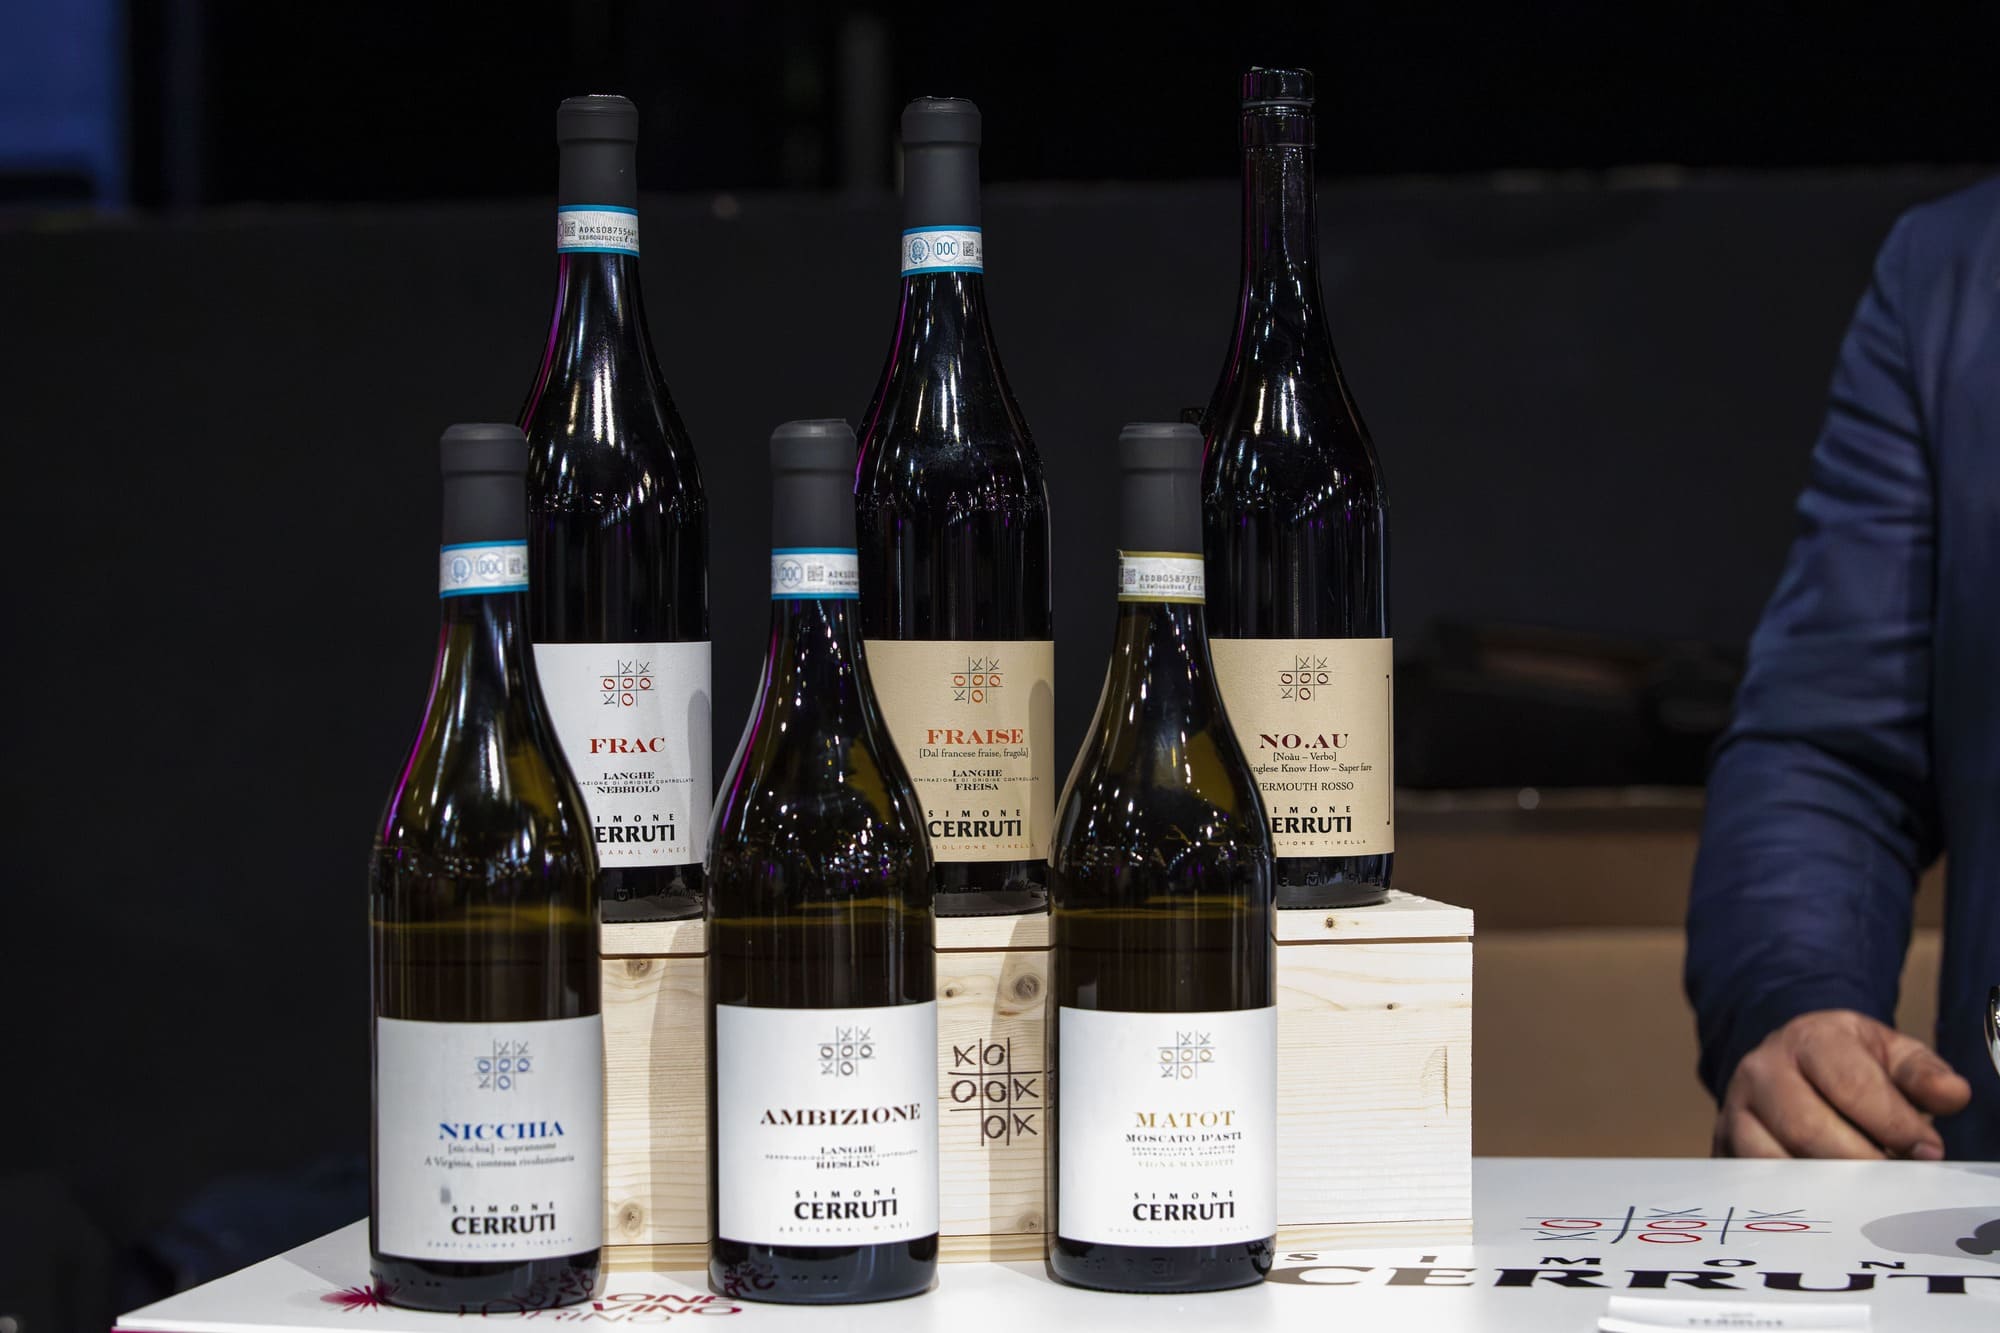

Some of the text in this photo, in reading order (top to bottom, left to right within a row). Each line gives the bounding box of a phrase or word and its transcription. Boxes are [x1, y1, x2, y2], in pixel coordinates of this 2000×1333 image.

[936, 242, 956, 256] DOC
[926, 729, 1024, 745] FRAISE
[1260, 734, 1348, 749] NO.AU
[589, 737, 665, 754] FRAC
[920, 748, 1028, 759] [Dal francese fraise, fragola]
[1310, 752, 1337, 762] Verbo]
[1282, 764, 1306, 773] Know
[1310, 764, 1330, 772] How
[1339, 763, 1359, 774] Saper
[1361, 762, 1372, 772] fare
[604, 772, 654, 780] LANGHE
[597, 785, 660, 794] NEBBIOLO
[1321, 782, 1354, 790] ROSSO
[928, 809, 1020, 818] SIMONE
[1274, 806, 1351, 814] IMONE
[597, 813, 674, 823] IMONE
[1272, 816, 1352, 833] ERRUTI
[594, 824, 675, 843] ERRUTI
[928, 820, 1021, 837] CERRUTI
[760, 1102, 921, 1126] AMBIZIONE
[1136, 1110, 1236, 1128] MATOT
[438, 1120, 564, 1140] NICCHIA
[1126, 1132, 1242, 1143] MOSCATO D'ASTI
[820, 1144, 876, 1155] LANGHE
[816, 1159, 880, 1169] RIESLING
[795, 1187, 896, 1198] SIMONE
[1134, 1190, 1233, 1200] SIMONE
[452, 1201, 554, 1214] SIMONE
[794, 1199, 898, 1220] CERRUTI
[1132, 1201, 1235, 1221] CERRUTI
[452, 1214, 556, 1236] CERRUTI
[1285, 1253, 1906, 1270] SIMON
[1267, 1266, 2000, 1294] CERRUT
[592, 1301, 743, 1316] VINO
